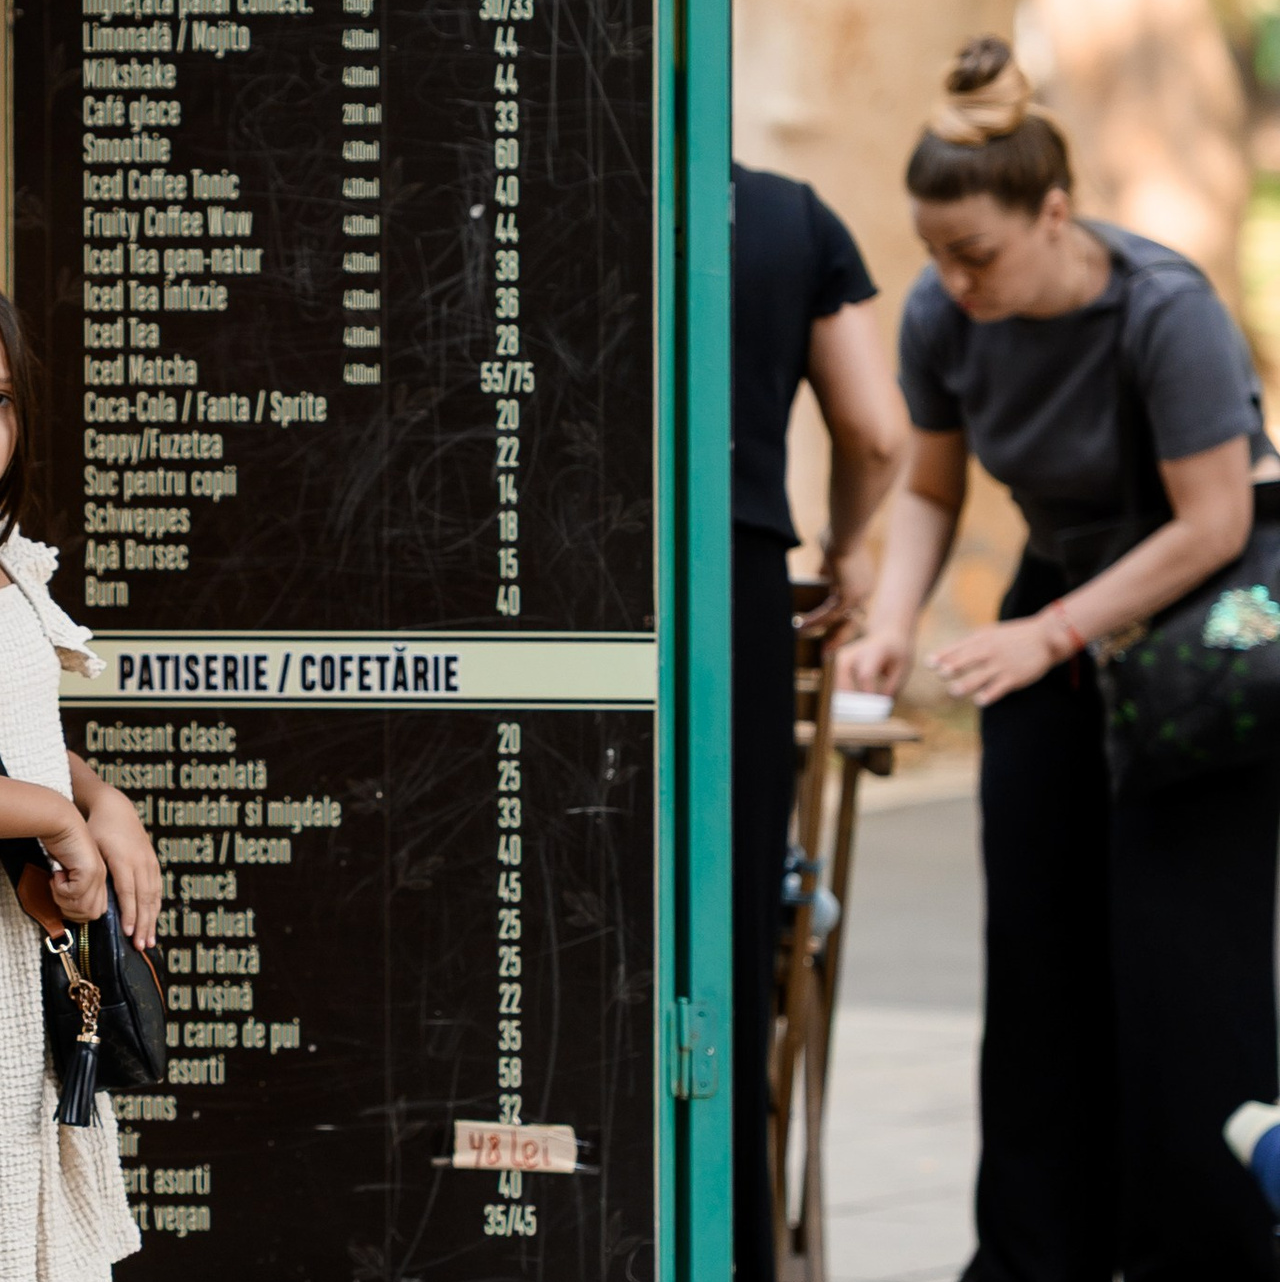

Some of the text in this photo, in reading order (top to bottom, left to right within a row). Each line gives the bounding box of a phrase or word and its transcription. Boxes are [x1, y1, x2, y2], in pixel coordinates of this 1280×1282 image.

[192, 21, 250, 58] Mojito
[495, 27, 518, 56] 44
[83, 58, 176, 88] Milkshake
[495, 64, 518, 93] 44
[129, 95, 180, 134] glace
[495, 101, 518, 131] 33
[83, 131, 170, 163] Smoothie
[495, 138, 518, 169] 60
[84, 169, 239, 200] Iced Coffee Tonic
[495, 176, 518, 206] 40
[84, 206, 252, 241] Fruity Coffee Wow
[495, 213, 519, 242] 44
[84, 243, 159, 274] Iced Tea
[496, 250, 518, 281] 38
[84, 277, 227, 311] Iced Tea infuzie
[496, 288, 519, 318] 36
[84, 317, 159, 348] Iced Tea
[496, 325, 519, 355] 28
[85, 354, 197, 385] Iced Matcha
[481, 361, 534, 393] 55/75
[85, 391, 326, 427] Coca-Cola Fanta Sprite
[496, 399, 519, 430] 20
[85, 428, 222, 467] Cappy/Fuzetea
[497, 436, 519, 467] 22
[85, 464, 236, 502] Suc pentru copii
[498, 474, 518, 504] 14
[85, 500, 190, 540] Schweppes
[498, 511, 518, 541] 18
[125, 538, 188, 569] Borsec
[498, 548, 518, 578] 15
[86, 575, 128, 606] Burn
[497, 585, 520, 615] 40
[118, 646, 459, 693] PATISERIE / COFETĂRIE
[87, 721, 236, 752] Croissant clasic
[498, 723, 520, 754] 20
[498, 760, 520, 791] 25
[158, 795, 240, 826] trandafir
[245, 796, 262, 826] si
[268, 796, 341, 833] migdale
[498, 798, 521, 828] 33
[235, 833, 290, 863] becon
[498, 835, 521, 865] 40
[498, 872, 521, 902] 45
[206, 907, 255, 937] aluat
[499, 909, 521, 939] 25
[168, 949, 191, 973] cu
[499, 946, 521, 976] 25
[168, 985, 191, 1010] cu
[499, 983, 521, 1013] 22
[184, 1022, 237, 1047] carne
[243, 1017, 265, 1047] de
[271, 1018, 299, 1054] pui
[499, 1020, 521, 1051] 35
[169, 1056, 224, 1084] asorti
[499, 1057, 521, 1087] 58
[154, 1165, 210, 1194] asorti
[154, 1206, 210, 1237] vegan
[484, 1205, 536, 1236] 35/45
